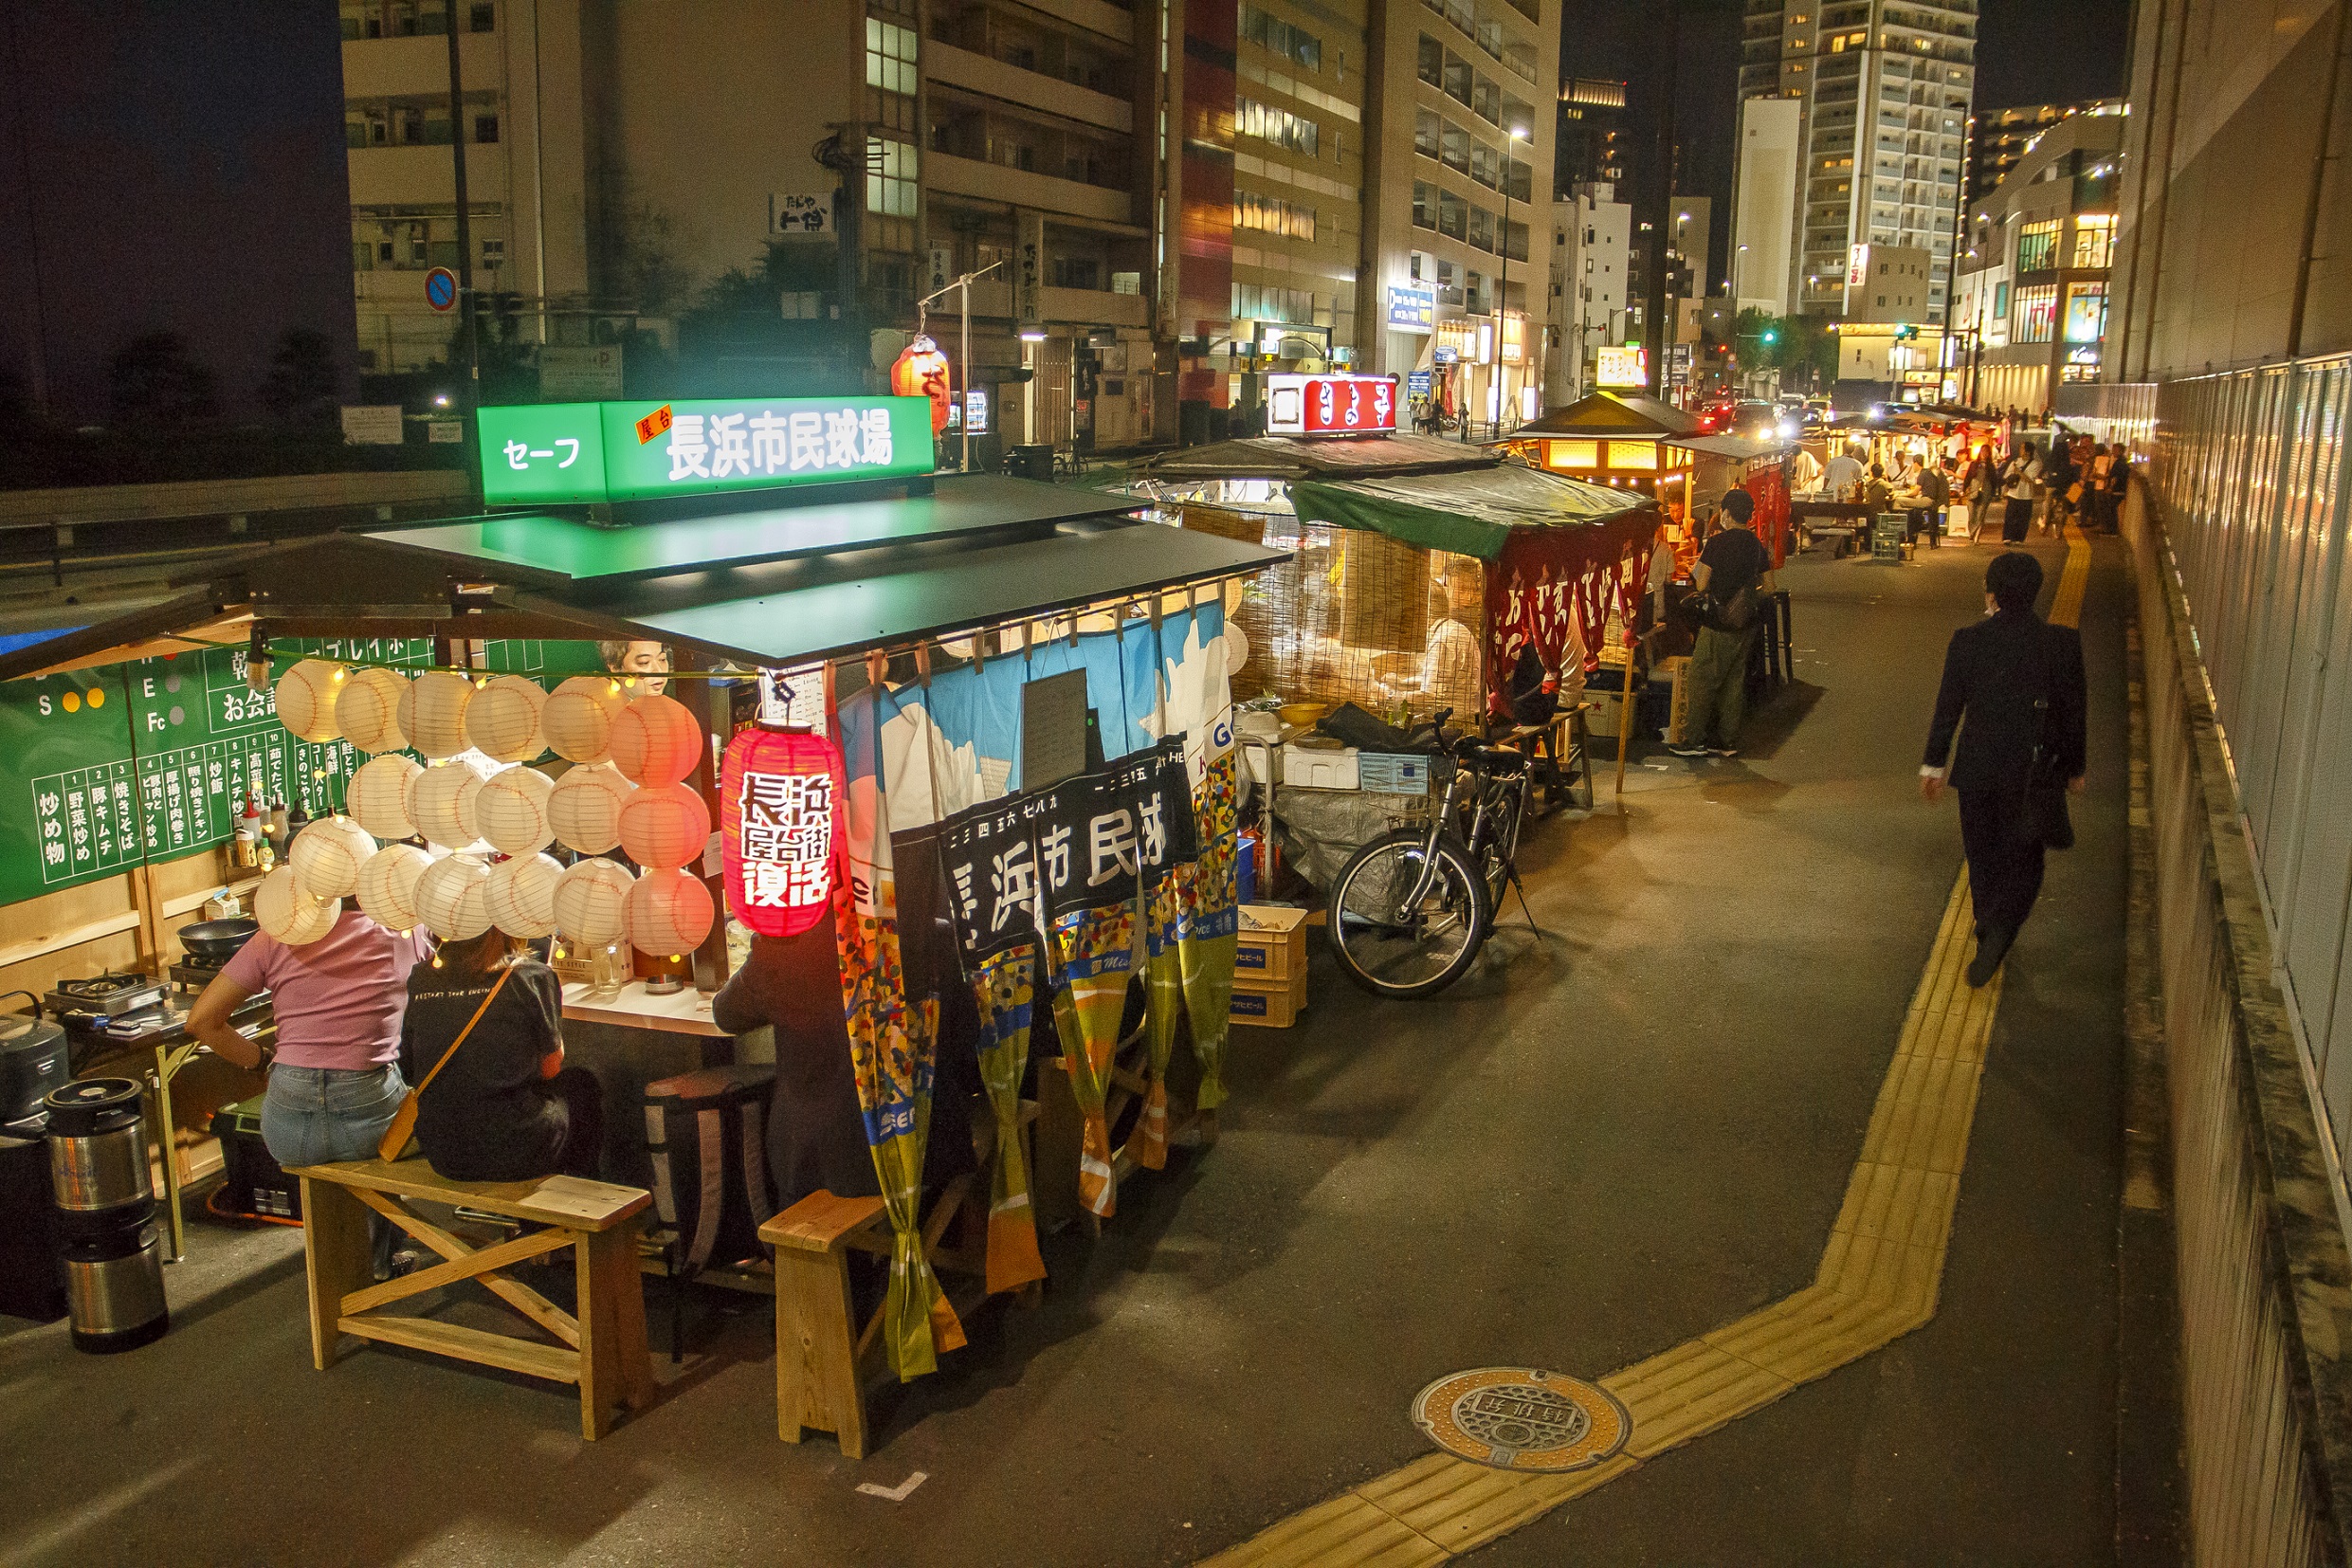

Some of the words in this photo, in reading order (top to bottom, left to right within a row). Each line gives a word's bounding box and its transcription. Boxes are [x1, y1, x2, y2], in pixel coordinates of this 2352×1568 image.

[641, 410, 672, 441] 屋台
[502, 438, 580, 470] セーフ
[665, 408, 894, 482] 長浜市民球場
[143, 678, 155, 699] E
[39, 695, 52, 716] S
[146, 712, 166, 733] Fc
[232, 741, 238, 750] 8
[252, 738, 257, 746] 9
[270, 733, 278, 742] 10
[168, 755, 174, 764] 5
[190, 751, 196, 759] 6
[211, 747, 217, 755] 7
[327, 745, 339, 775] 海鮮
[96, 770, 102, 779] 2
[119, 765, 125, 774] 3
[147, 760, 153, 769] 4
[72, 775, 77, 784] 1
[209, 761, 224, 795] 炒飯
[149, 774, 163, 811] 豚肉と
[187, 765, 208, 840] 照り焼きチキン
[114, 781, 135, 850] 焼きそば
[165, 770, 185, 845] 厚揚げ肉巻き
[39, 792, 65, 866] 炒め物
[68, 791, 91, 861] 野菜炒め
[91, 786, 112, 856] 豚キムチ
[742, 860, 831, 907] 復活
